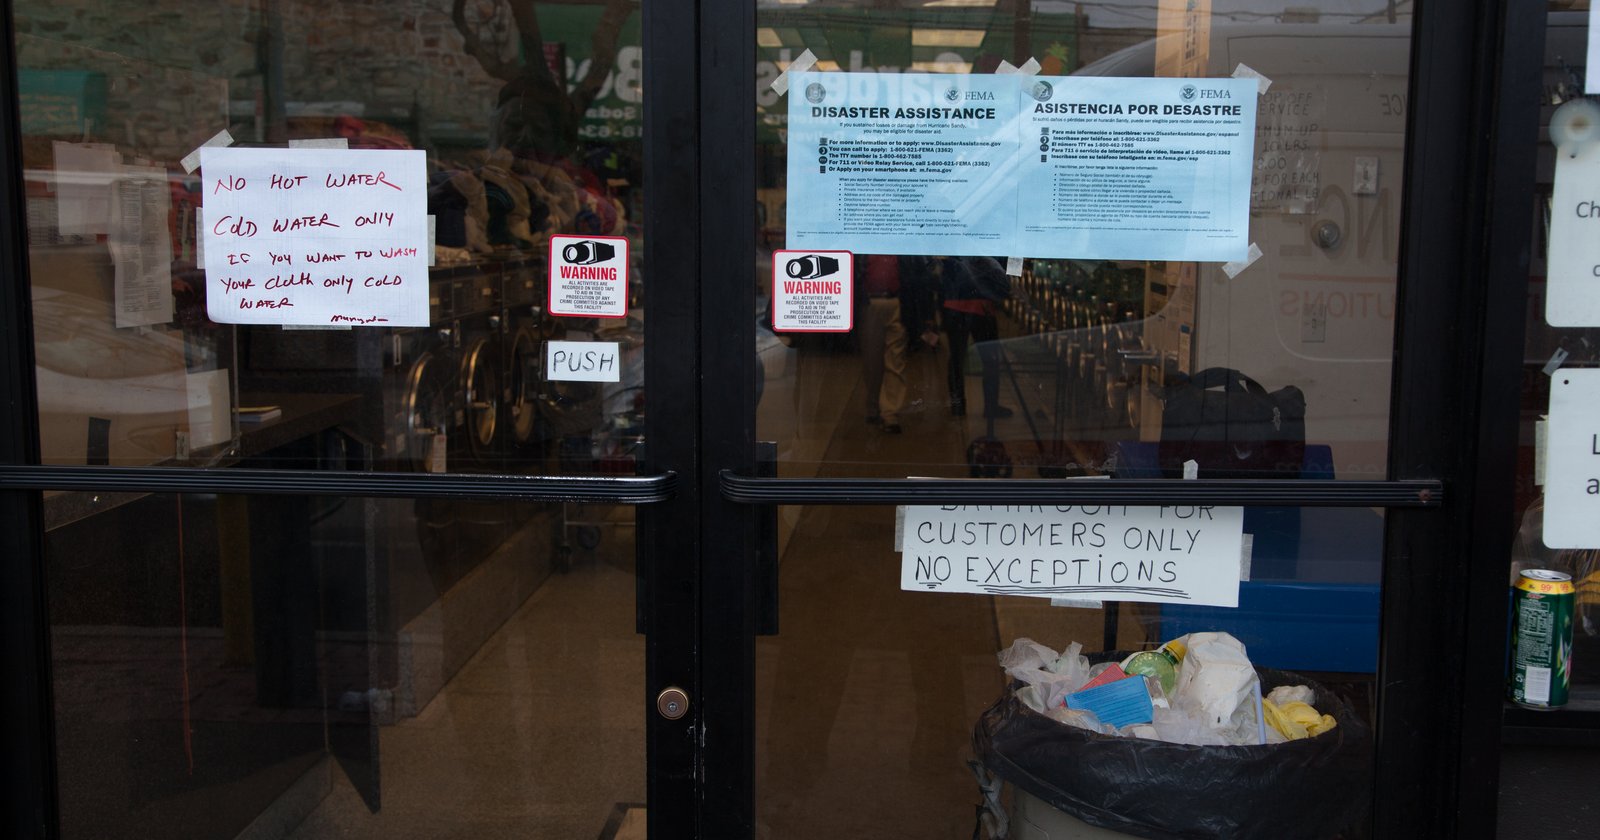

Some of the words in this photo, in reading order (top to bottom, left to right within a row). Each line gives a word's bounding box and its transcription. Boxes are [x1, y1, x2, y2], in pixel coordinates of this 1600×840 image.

[965, 92, 995, 101] FEMA
[1200, 89, 1231, 99] FEMA
[812, 107, 889, 119] DISASTER
[895, 108, 996, 119] ASSISTANCE
[1034, 103, 1123, 115] ASISTENCIA
[1128, 104, 1158, 115] POR
[1164, 104, 1241, 116] DESASTRE
[1259, 103, 1309, 116] ERVICE
[214, 176, 246, 195] NO
[270, 174, 308, 190] HOT
[326, 171, 402, 191] WATER
[1252, 189, 1300, 202] TIONAL
[272, 214, 340, 233] WATER
[268, 252, 292, 266] YOU
[306, 253, 346, 264] WANT
[355, 251, 373, 260] TO
[379, 247, 416, 259] WASH
[560, 266, 617, 281] WARNING
[220, 278, 256, 295] YOUR
[784, 281, 842, 295] WARNING
[240, 298, 294, 309] WATER
[553, 350, 614, 373] PUSH
[917, 521, 1106, 548] CUSTOMERS
[1124, 527, 1201, 554] ONLY
[915, 556, 952, 583] NO
